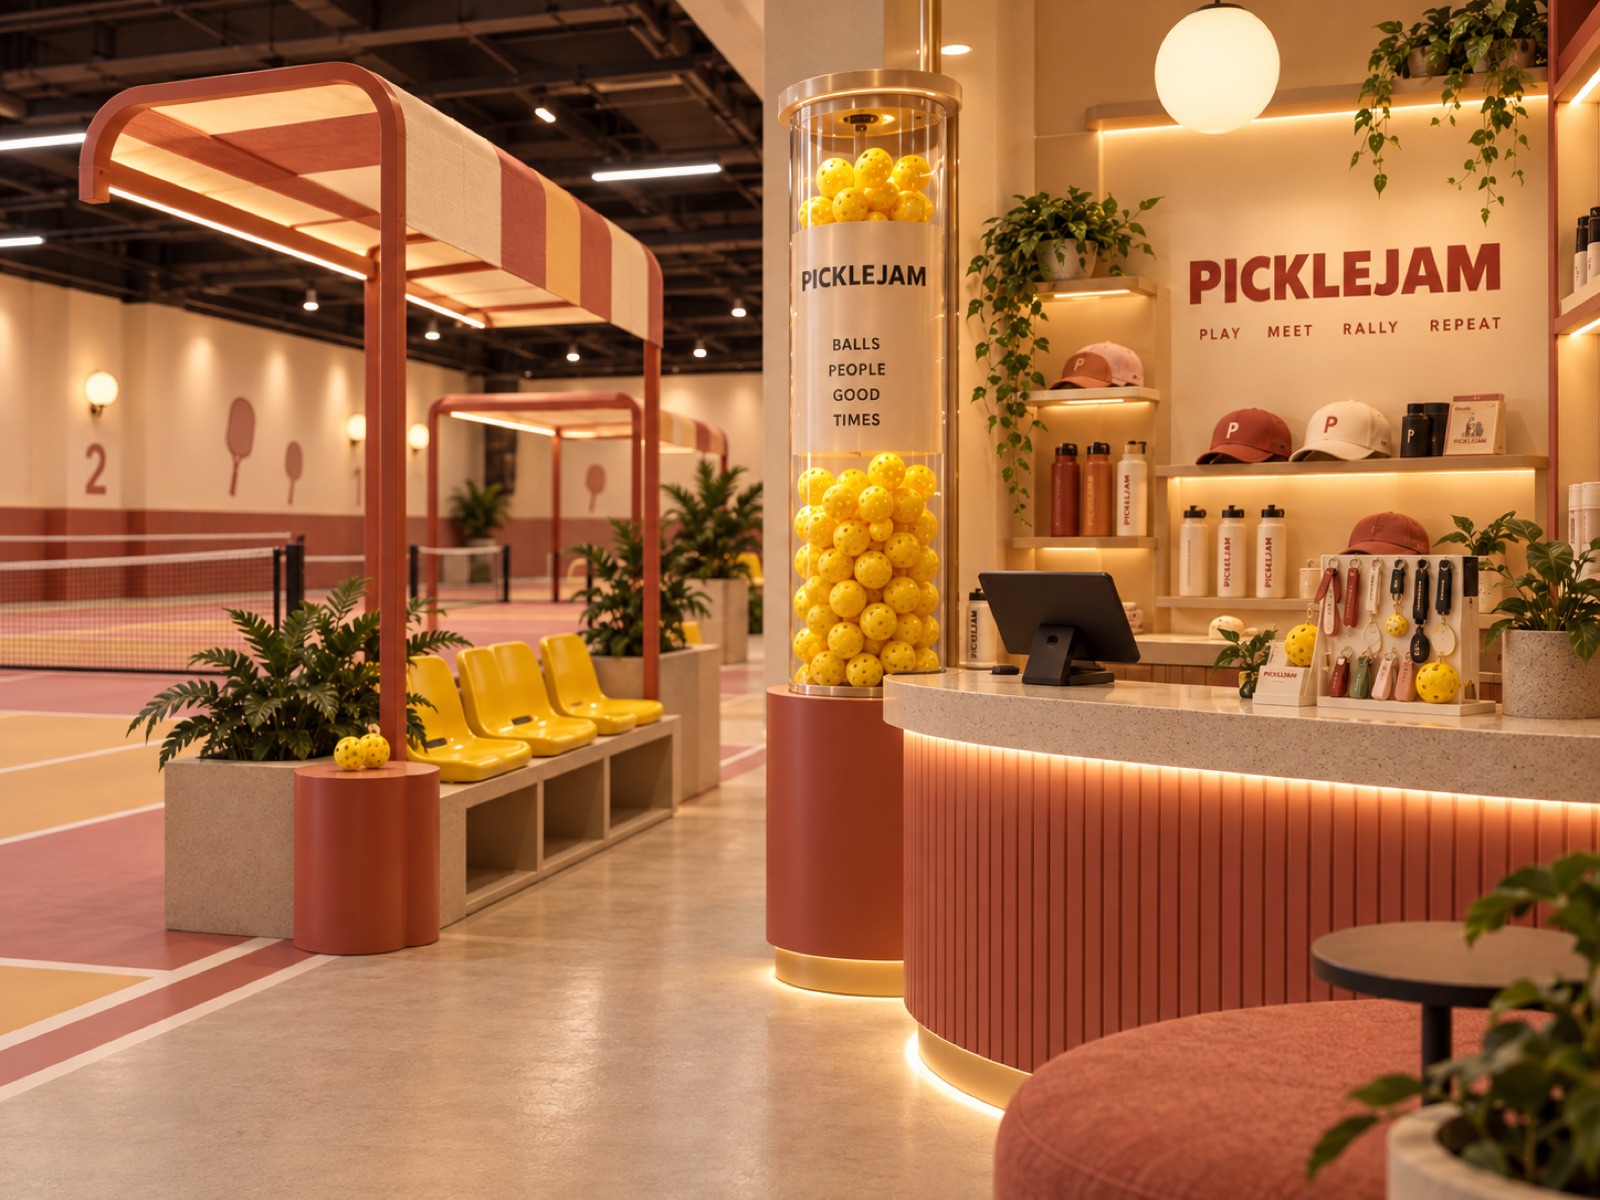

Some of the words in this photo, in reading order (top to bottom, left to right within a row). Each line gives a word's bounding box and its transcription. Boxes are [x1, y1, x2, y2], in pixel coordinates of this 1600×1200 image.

[801, 264, 927, 292] PICKLEJAM
[1189, 243, 1501, 305] PICKLEJAM
[1199, 327, 1241, 341] PLAY
[1267, 324, 1313, 338] MEET
[1343, 321, 1398, 336] RALLY
[1430, 317, 1501, 332] REPEAT
[832, 337, 881, 351] BALLS
[828, 363, 886, 377] PEOPLE
[1073, 357, 1085, 372] P
[832, 388, 881, 402] GOOD
[833, 413, 881, 427] TIMES
[1323, 415, 1338, 434] P
[1225, 421, 1240, 439] P
[1407, 429, 1415, 444] P
[85, 443, 106, 495] 2
